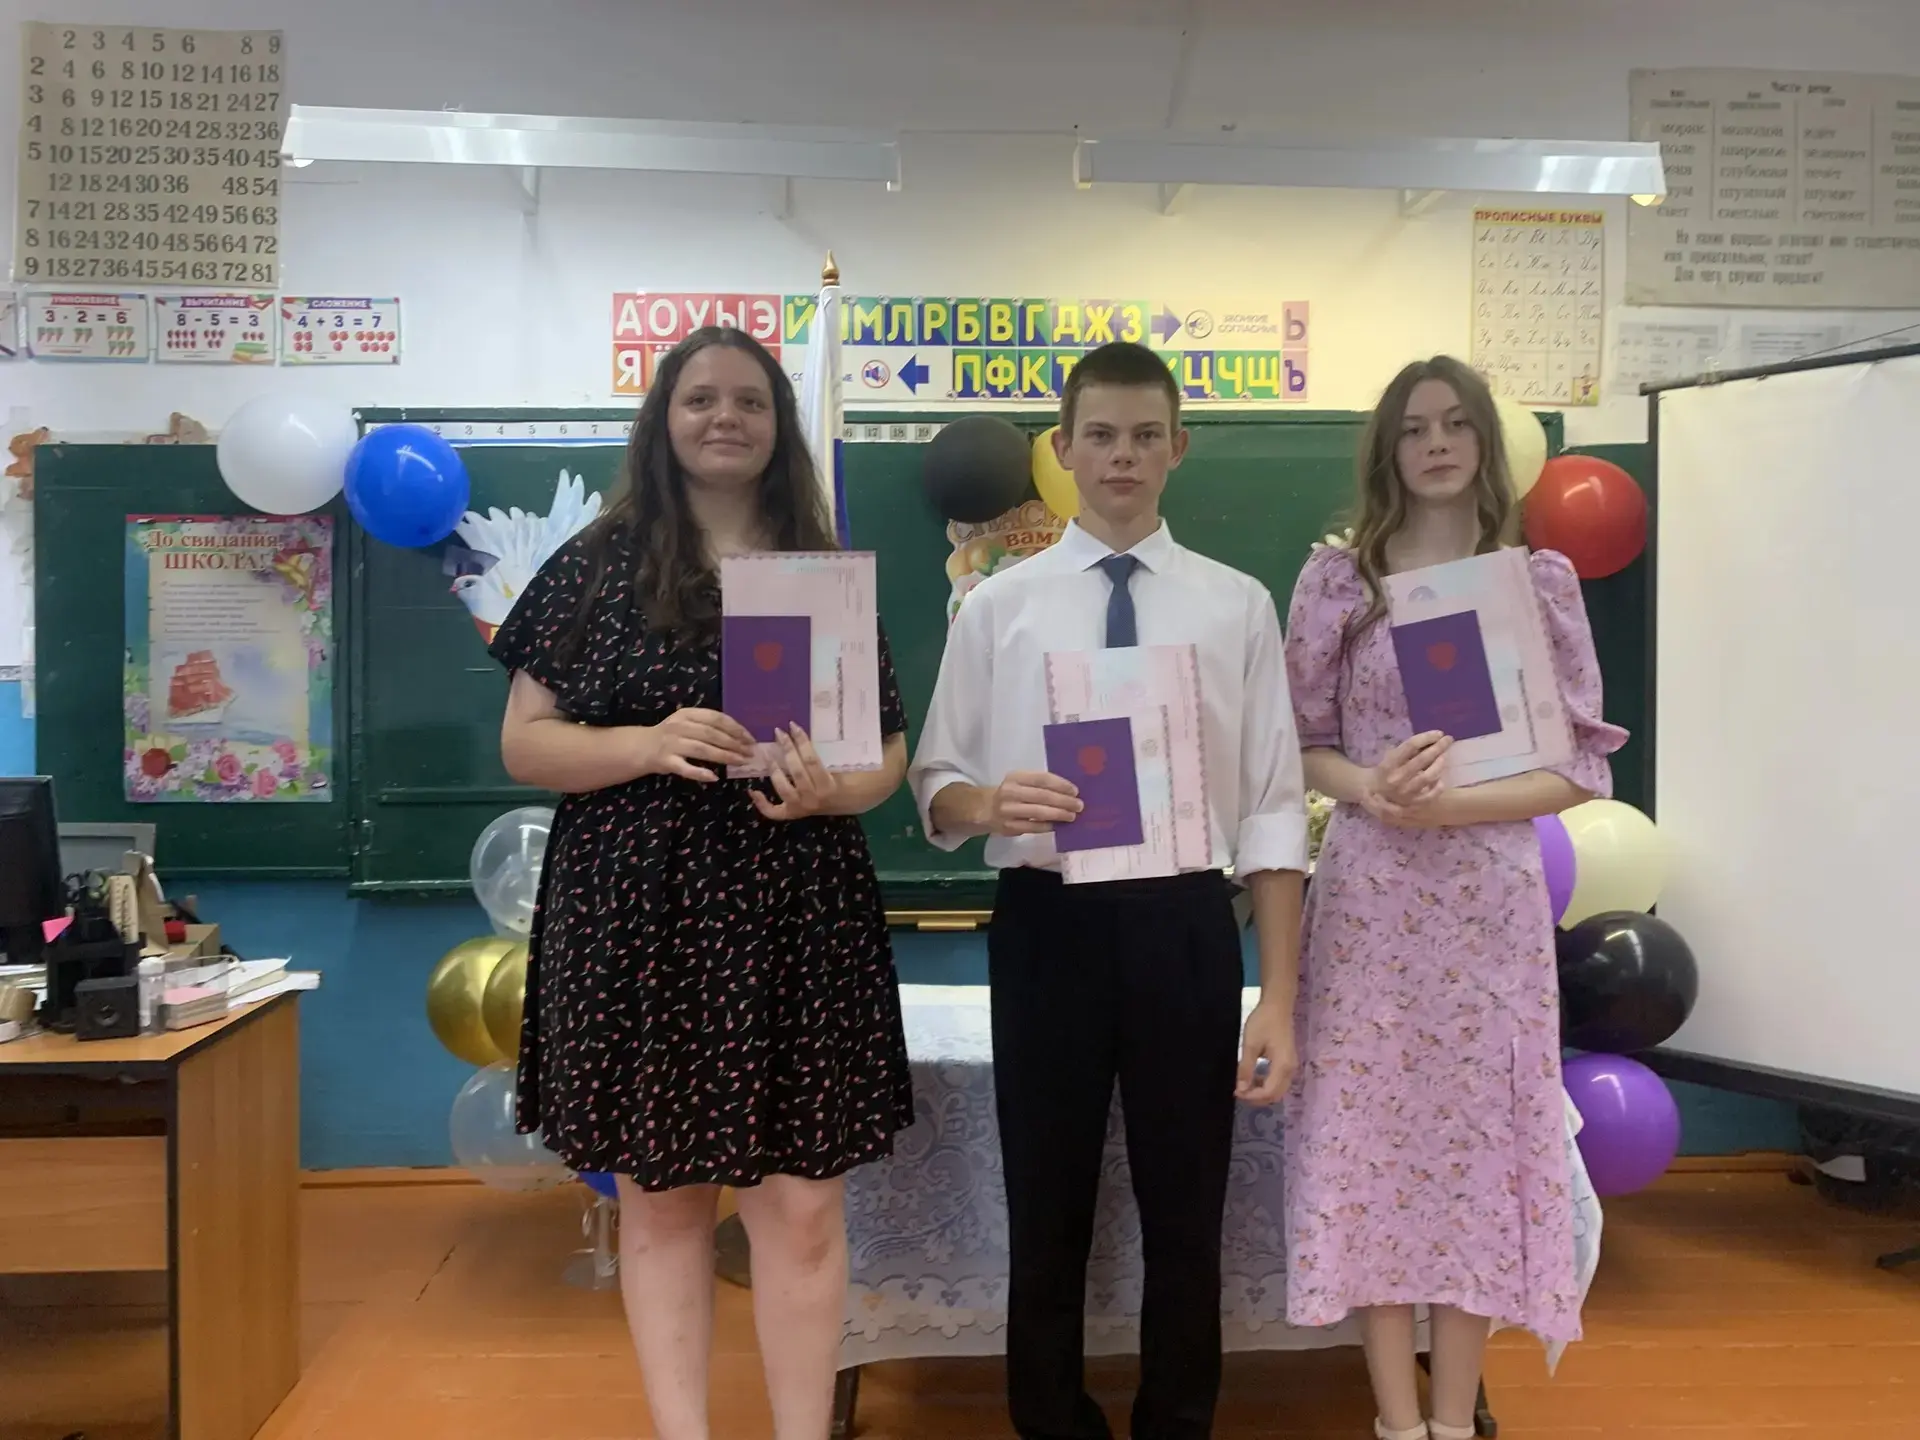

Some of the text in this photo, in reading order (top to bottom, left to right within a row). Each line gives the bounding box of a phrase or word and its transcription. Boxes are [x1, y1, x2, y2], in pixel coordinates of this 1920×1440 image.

[63, 30, 280, 54] 2 3 4 5 6 8 9
[30, 57, 279, 84] 2 4 6 8 10 12 14 16 18
[29, 85, 279, 111] 3 6 9 12 15 18 21 24 27
[27, 115, 279, 140] 4 8 12 16 20 24 28 32 36
[27, 142, 280, 168] 5 10 15 20 25 30 35 40 45
[49, 173, 278, 196] 12 18 24 30 36 48 54
[27, 200, 277, 225] 7 14 21 28 35 42 49 56 63
[1475, 211, 1603, 223] ПРОПИСНЫЕ БУКВЫ
[25, 229, 277, 254] 8 16 24 32 40 48 56 64 72
[25, 257, 273, 282] 9 18 27 36 45 54 63 72 81
[186, 298, 246, 307] ВЫЧИТАНИЕ
[312, 299, 367, 308] СЛОЖЕНИЕ
[45, 310, 55, 322] 3
[77, 310, 88, 323] 2
[116, 311, 127, 324] 6
[177, 313, 186, 326] 8
[210, 313, 220, 326] 5
[248, 314, 259, 327] 3
[297, 315, 308, 328] 4
[333, 315, 344, 327] 3
[371, 315, 382, 328] 7
[465, 424, 473, 435] 3
[497, 424, 504, 435] 4
[529, 424, 536, 435] 5
[559, 424, 568, 435] 6
[591, 424, 598, 434] 7
[623, 424, 630, 434] 8
[146, 528, 173, 548] До
[1005, 531, 1054, 548] вам
